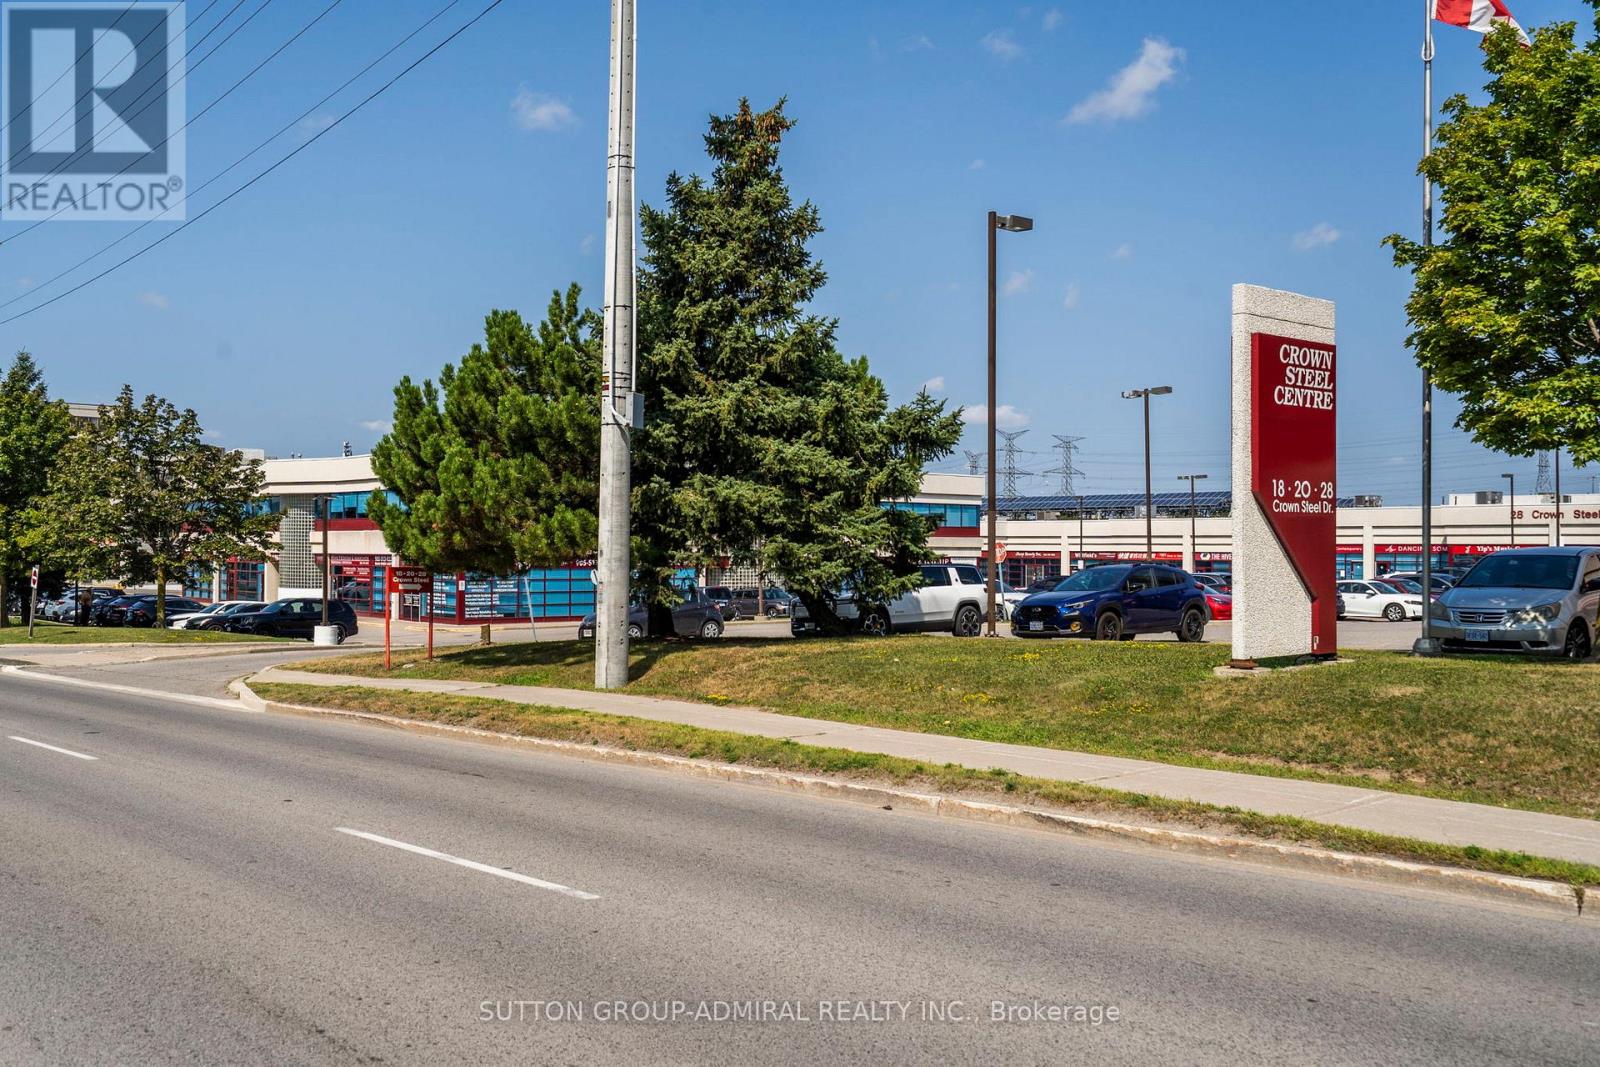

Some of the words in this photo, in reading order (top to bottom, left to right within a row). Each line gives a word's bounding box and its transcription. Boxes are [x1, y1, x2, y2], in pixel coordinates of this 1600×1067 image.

[1279, 344, 1334, 370] CROWN
[1285, 365, 1333, 390] STEEL
[1274, 385, 1334, 410] CENTRE
[1272, 479, 1285, 497] 18
[1294, 480, 1311, 498] 20
[1320, 481, 1334, 499] 28
[1272, 499, 1300, 513] Crown
[1301, 500, 1321, 513] Steel
[1323, 501, 1334, 513] Dr.
[1511, 510, 1523, 519] 28
[1532, 510, 1564, 519] Crown
